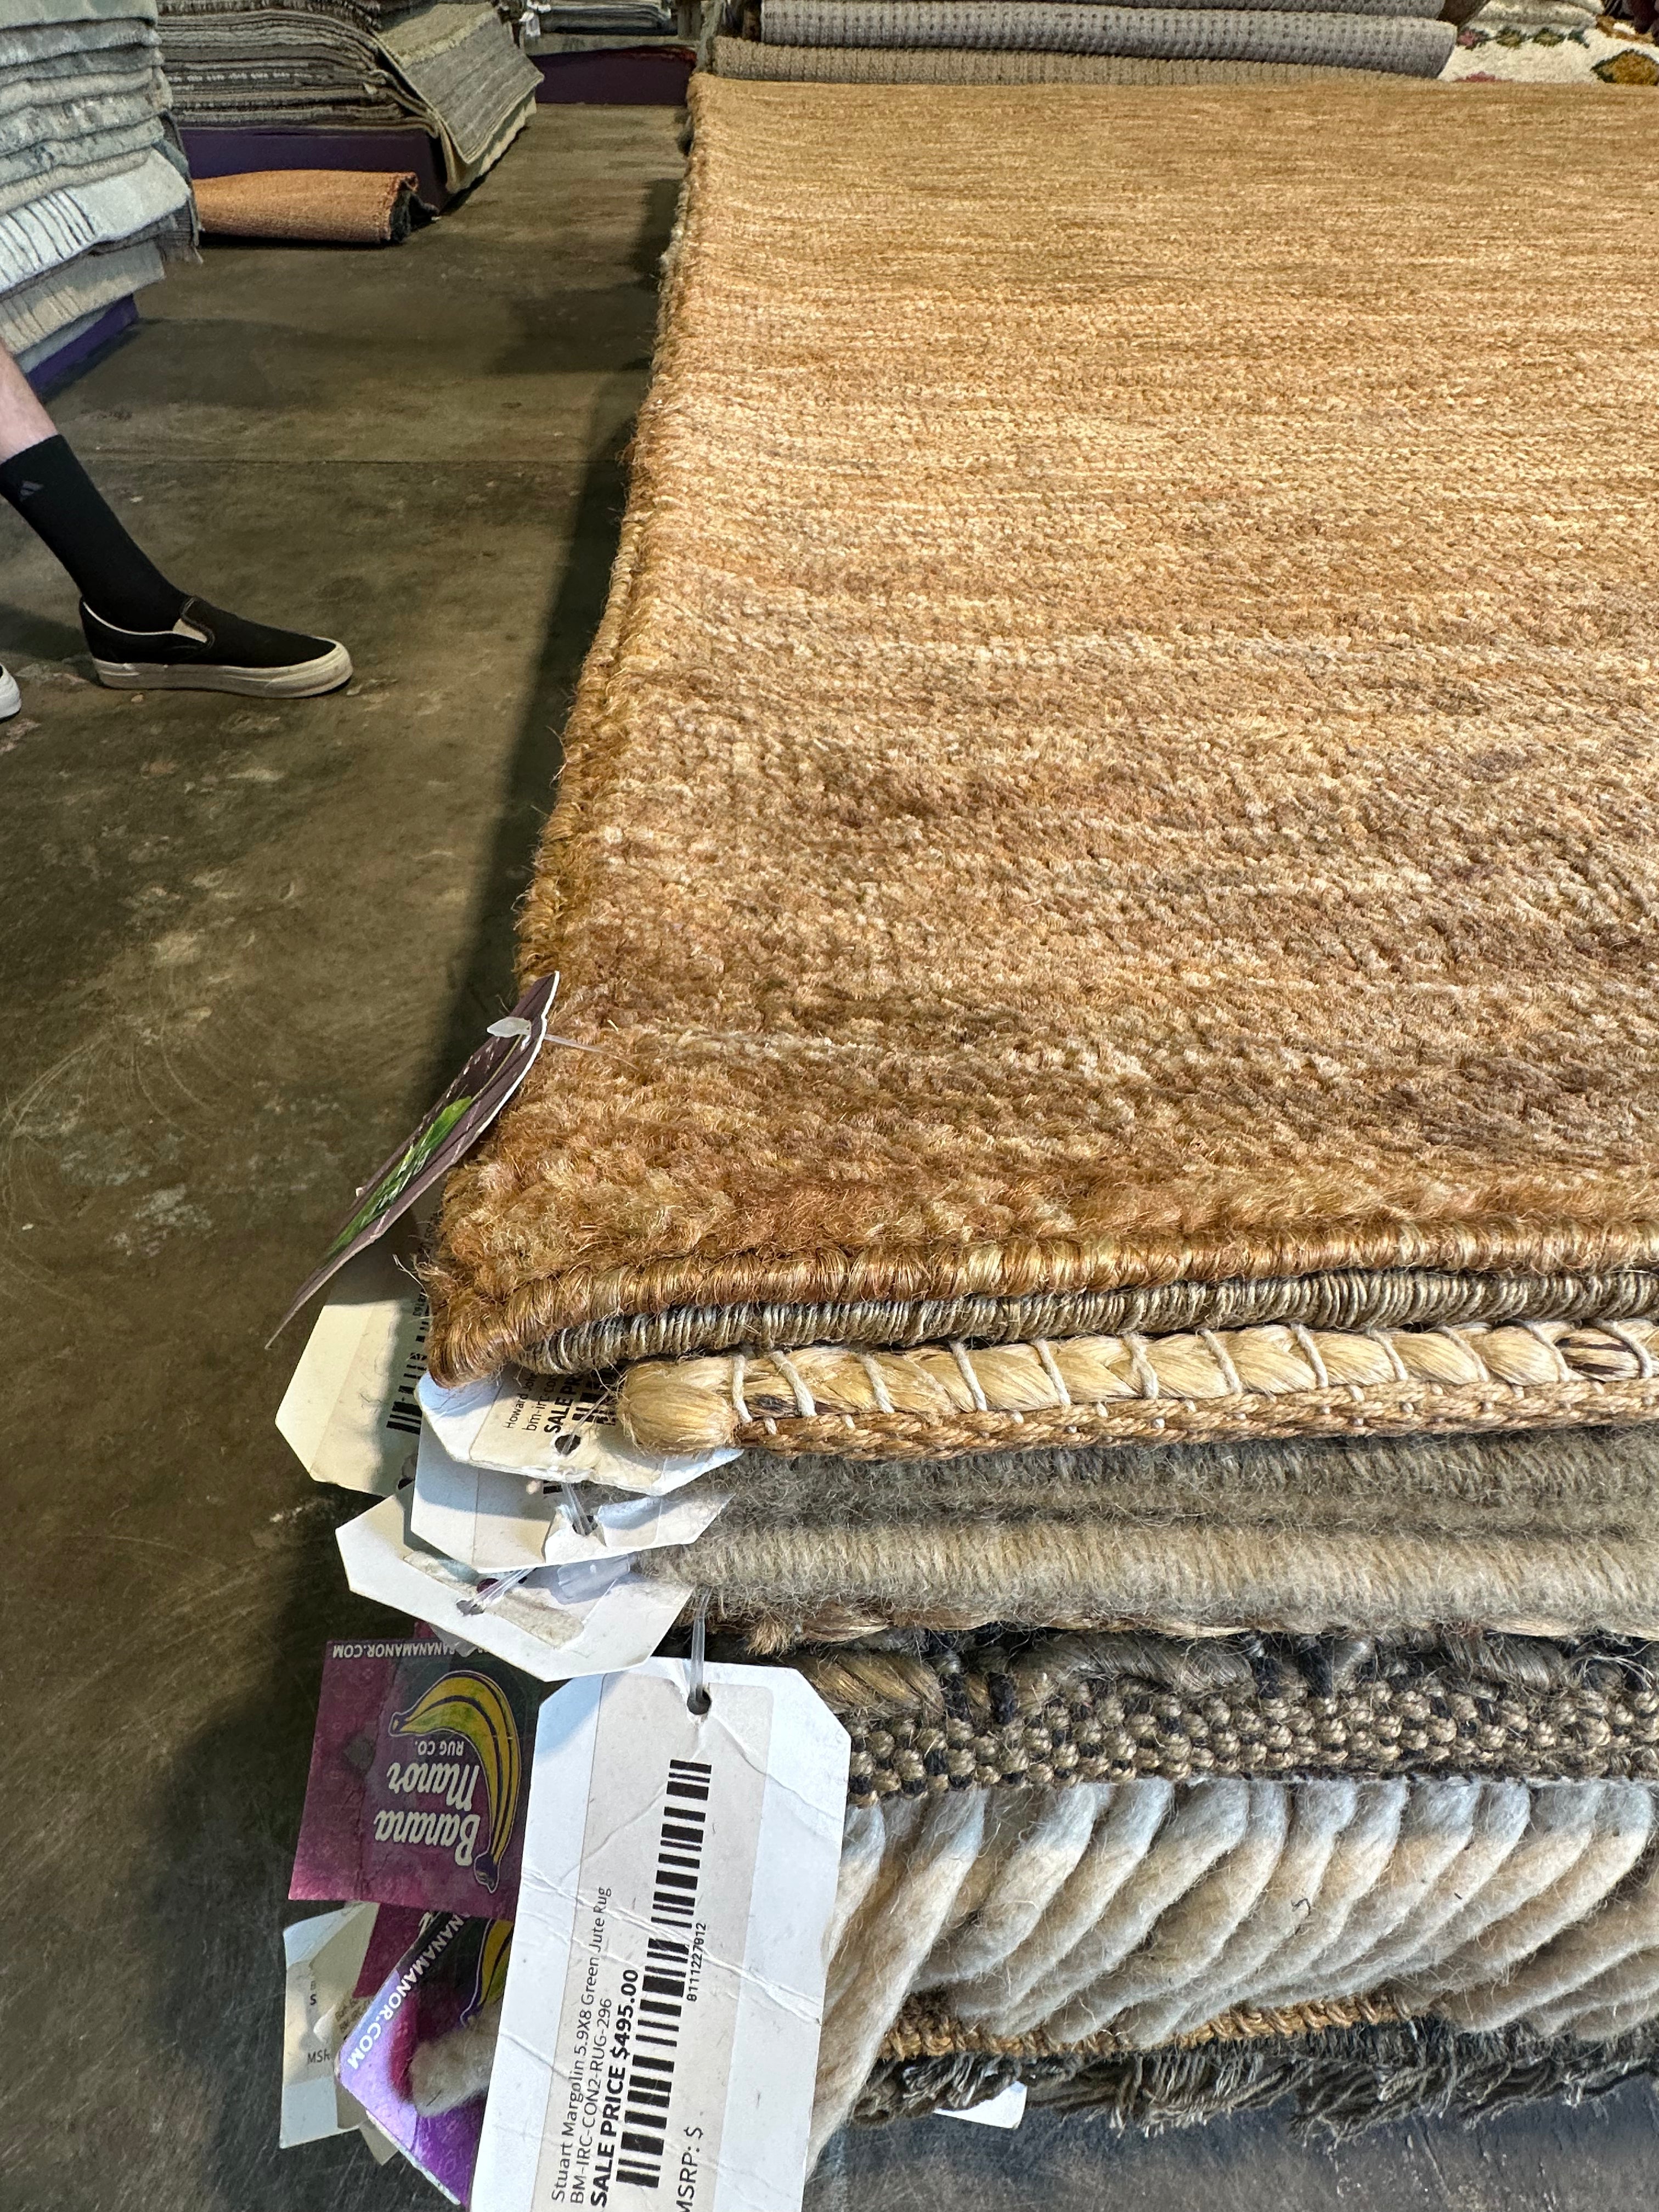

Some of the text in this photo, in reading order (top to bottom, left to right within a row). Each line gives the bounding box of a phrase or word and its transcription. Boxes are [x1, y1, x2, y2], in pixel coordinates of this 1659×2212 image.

[503, 1392, 528, 1429] Howard
[544, 1397, 574, 1433] SALE
[414, 1740, 465, 1756] RUG CO.
[386, 1762, 480, 1812] Manor
[373, 1810, 481, 1866] Banana
[551, 1887, 612, 2202] Stuart Margolin 5.9X8 Green Jute Rug
[570, 1997, 612, 2204] BM-IRC-CON2-RUG-296
[590, 1969, 639, 2208] SALE PRICE $495.00
[676, 2126, 704, 2212] MSRP: $
